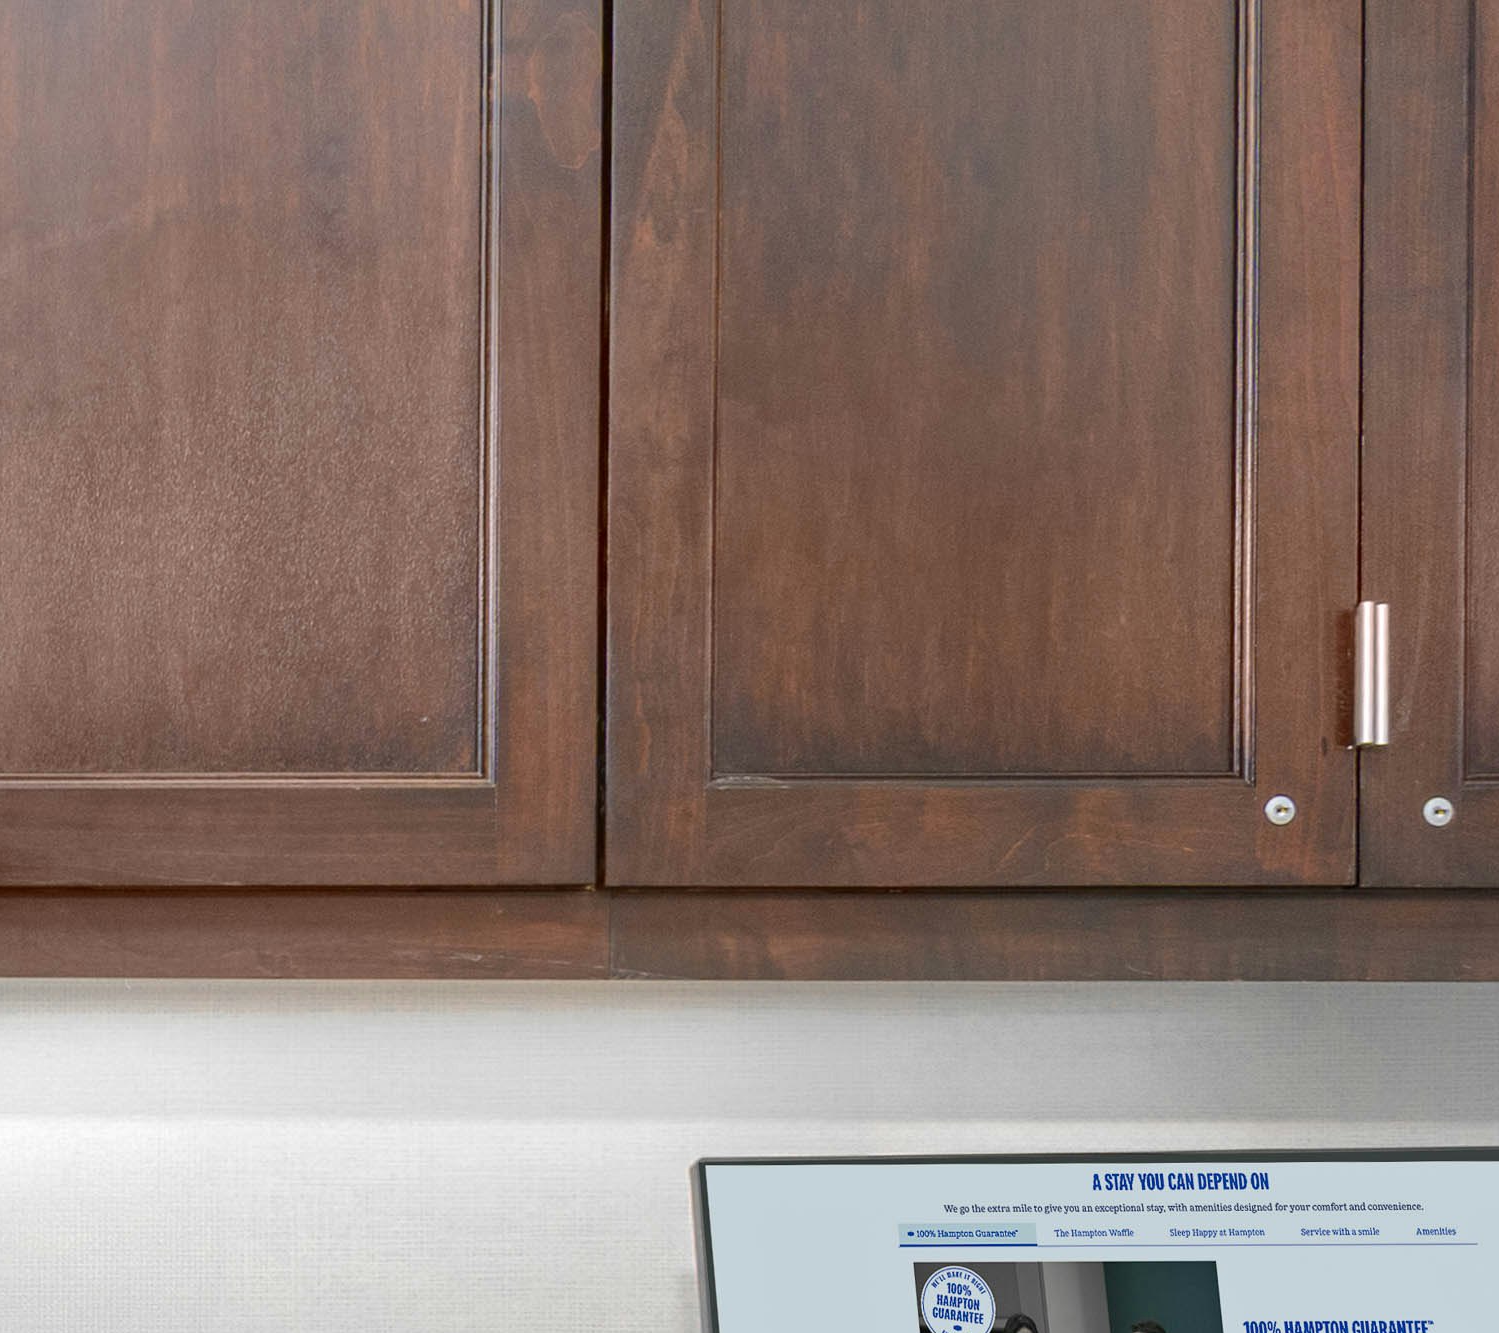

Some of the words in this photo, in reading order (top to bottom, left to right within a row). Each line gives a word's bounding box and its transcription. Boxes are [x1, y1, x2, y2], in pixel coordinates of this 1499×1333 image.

[1093, 1174, 1102, 1190] A
[1105, 1173, 1134, 1190] STAY
[1138, 1173, 1164, 1190] YOU
[1168, 1173, 1194, 1190] CAN
[1197, 1173, 1247, 1190] DEPEND
[1251, 1173, 1269, 1190] ON
[943, 1204, 959, 1214] We
[958, 1205, 971, 1216] go
[971, 1203, 986, 1213] the
[986, 1204, 1011, 1214] extra
[1012, 1203, 1033, 1213] mile
[1033, 1204, 1044, 1213] to
[1043, 1203, 1063, 1215] give
[1063, 1205, 1080, 1215] you
[1081, 1205, 1094, 1213] an
[1094, 1202, 1145, 1215] exceptional
[1146, 1203, 1167, 1215] stay,
[1166, 1202, 1188, 1213] with
[1189, 1202, 1233, 1213] amenities
[1233, 1202, 1274, 1214] designed
[1274, 1202, 1289, 1212] for
[1289, 1204, 1311, 1214] your
[1311, 1201, 1348, 1212] comfort
[1348, 1201, 1367, 1212] and
[1367, 1201, 1425, 1212] convenience.
[947, 1283, 971, 1296] 100%
[937, 1294, 980, 1310] HAMPTON
[932, 1307, 984, 1324] GUARANTEE
